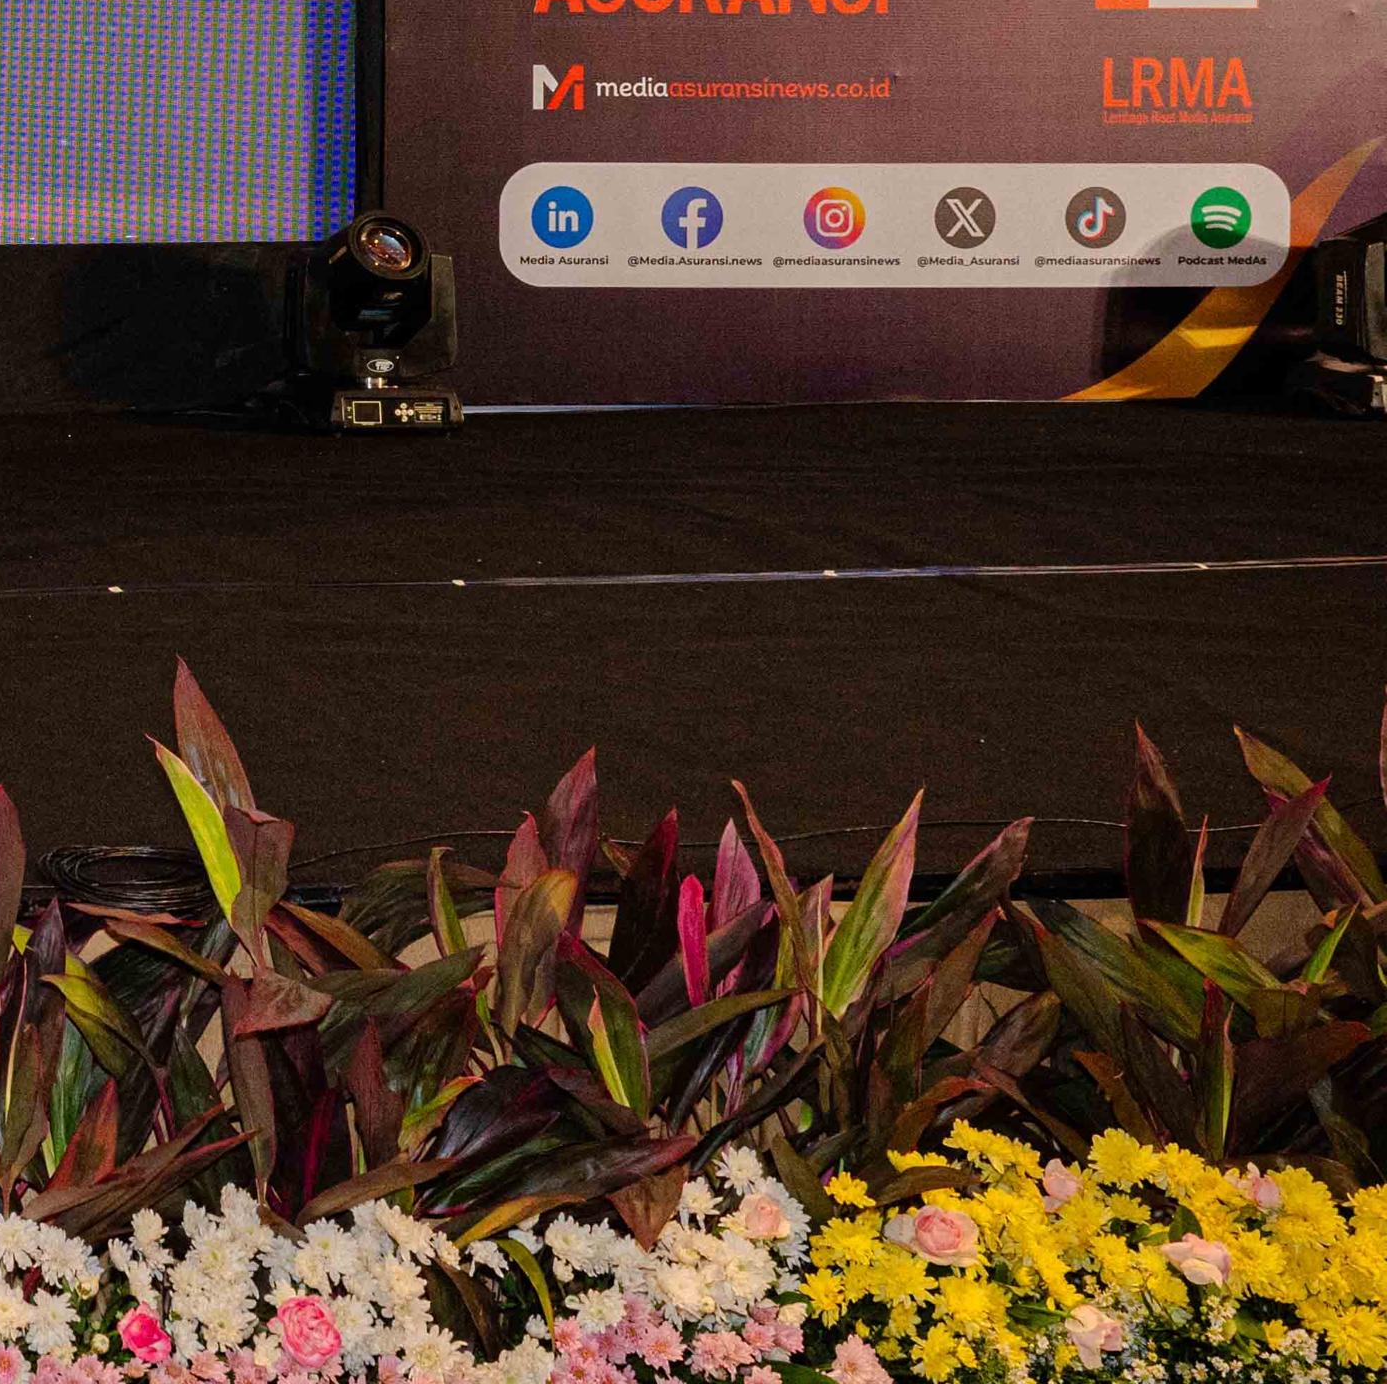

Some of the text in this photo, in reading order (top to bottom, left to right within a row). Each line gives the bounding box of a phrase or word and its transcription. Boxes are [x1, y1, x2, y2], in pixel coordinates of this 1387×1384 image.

[595, 76, 892, 98] mediaasuransinews.co.id
[1103, 56, 1253, 108] LRMA
[519, 255, 609, 265] Media Asuransi
[627, 255, 763, 267] @Media.Asuransi.news
[772, 256, 901, 268] @mediaasuransinews
[917, 255, 1020, 268] @Media_Asuransi
[1034, 256, 1162, 268] @mediaasuransinews
[1177, 255, 1267, 266] Podcast MedAs
